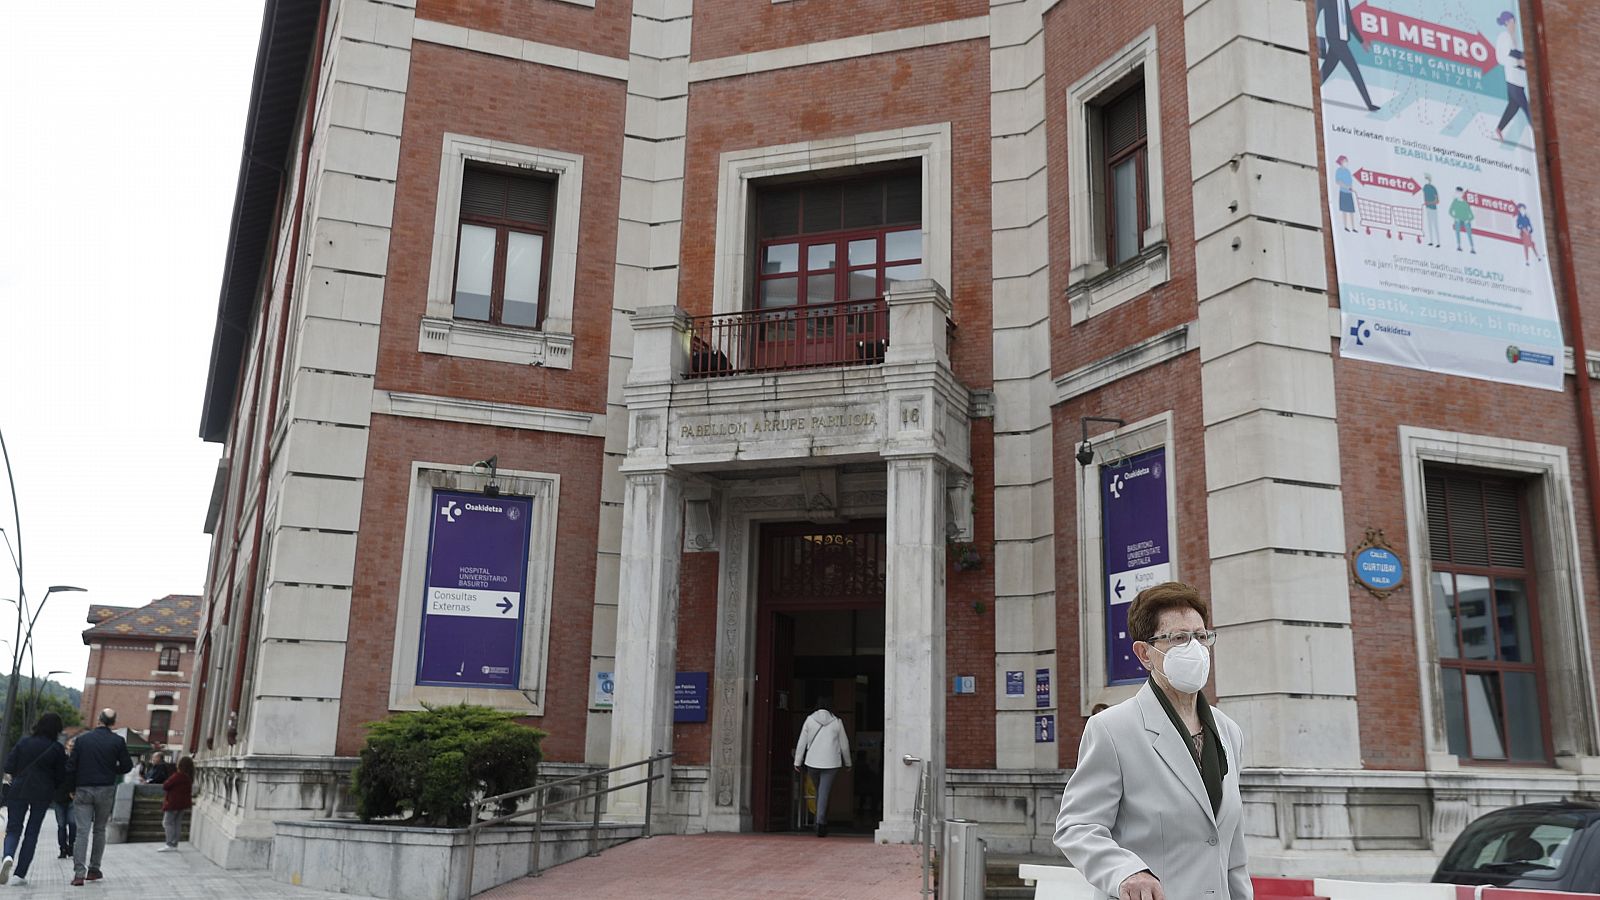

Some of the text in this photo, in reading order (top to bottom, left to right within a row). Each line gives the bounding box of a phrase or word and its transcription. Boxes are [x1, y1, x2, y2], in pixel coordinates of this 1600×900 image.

[1360, 12, 1489, 62] BI METRO
[1373, 44, 1482, 79] BATZEN GAITUEN
[1394, 145, 1482, 172] ERABILI MASKARA
[1360, 171, 1416, 191] Bi metro
[1466, 193, 1516, 213] Bi metro
[1464, 266, 1505, 282] ISOLATU
[1349, 291, 1414, 316] Nigatik,
[1419, 305, 1484, 330] zugatik,
[1488, 315, 1501, 331] bi
[1507, 320, 1557, 340] metro.
[1374, 322, 1411, 337] Osakidetza
[681, 422, 747, 437] PABELLON
[753, 417, 805, 433] ARRUPE
[465, 503, 503, 513] Osakidetza
[459, 567, 490, 575] HOSPITAL
[459, 573, 508, 583] UNIVERSITARIO
[458, 580, 489, 588] BASURTO
[434, 590, 477, 601] Consultas
[432, 601, 471, 612] Externas
